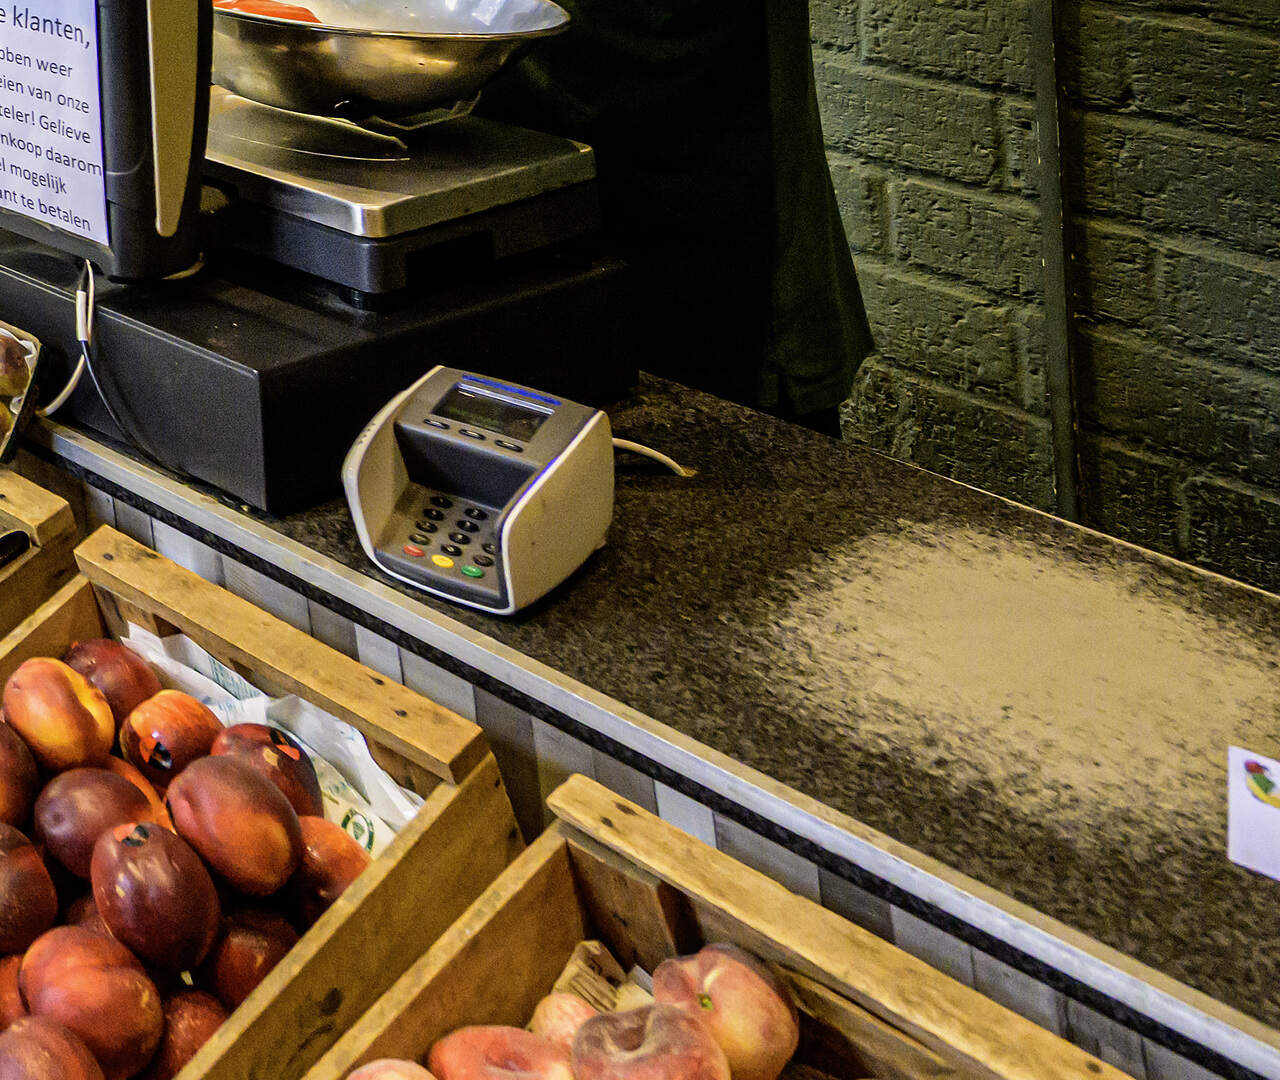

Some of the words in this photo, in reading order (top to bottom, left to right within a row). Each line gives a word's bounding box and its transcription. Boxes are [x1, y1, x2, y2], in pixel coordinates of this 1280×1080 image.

[13, 5, 92, 49] klanten,
[36, 58, 74, 79] weer
[28, 82, 52, 103] van
[57, 94, 90, 115] onze
[39, 114, 92, 145] Gelieve
[10, 161, 68, 195] mogelijk
[46, 146, 103, 177] daarom
[20, 192, 35, 209] te
[38, 200, 92, 233] betalen
